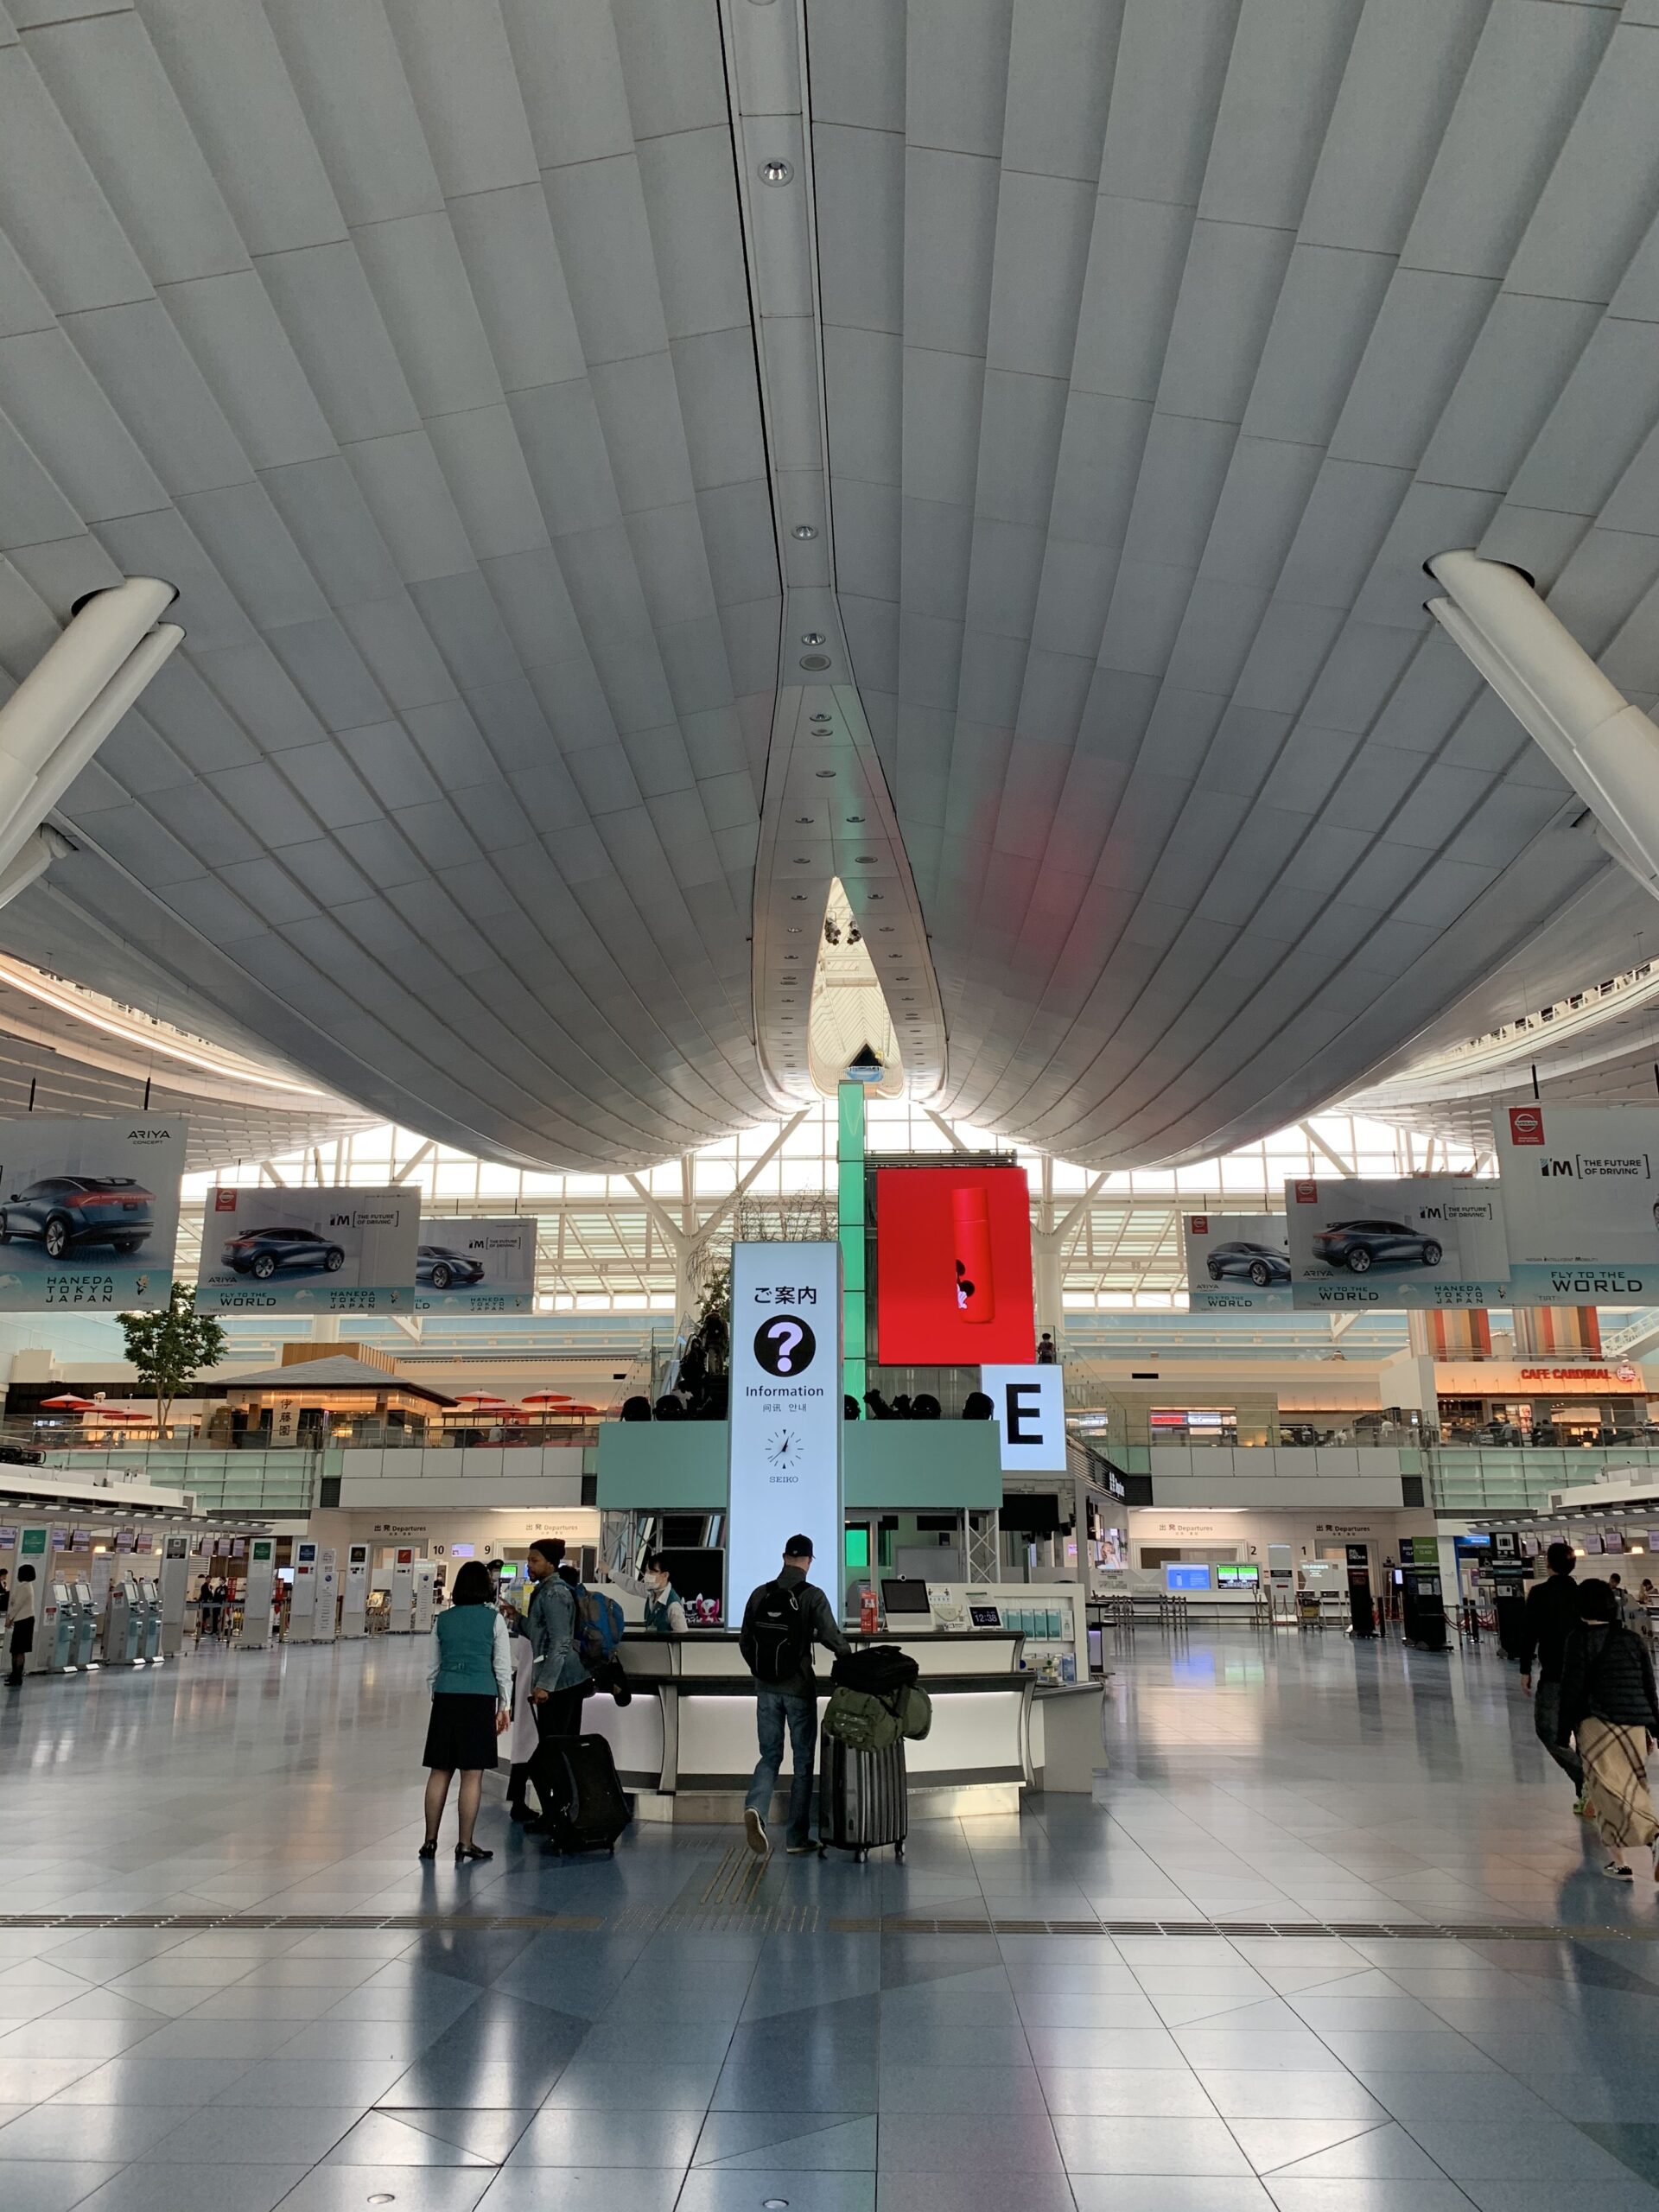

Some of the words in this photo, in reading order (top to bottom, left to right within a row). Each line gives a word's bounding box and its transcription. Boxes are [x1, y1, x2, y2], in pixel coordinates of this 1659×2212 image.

[127, 1130, 171, 1139] ARIYA
[47, 1285, 113, 1294] TOKYO
[1552, 1280, 1643, 1293] WORLD
[754, 1286, 817, 1305] ご案内
[1319, 1292, 1379, 1300] WORLD
[1521, 1369, 1550, 1380] CAFE
[1553, 1369, 1611, 1380] CARDINAL
[746, 1385, 823, 1396] Information
[788, 1403, 807, 1413] 안내
[1006, 1383, 1044, 1445] E
[433, 1545, 444, 1554] 10
[484, 1545, 491, 1554] 9
[1250, 1546, 1257, 1555] 2
[1301, 1546, 1306, 1555] 1
[975, 1613, 997, 1623] 12:38
